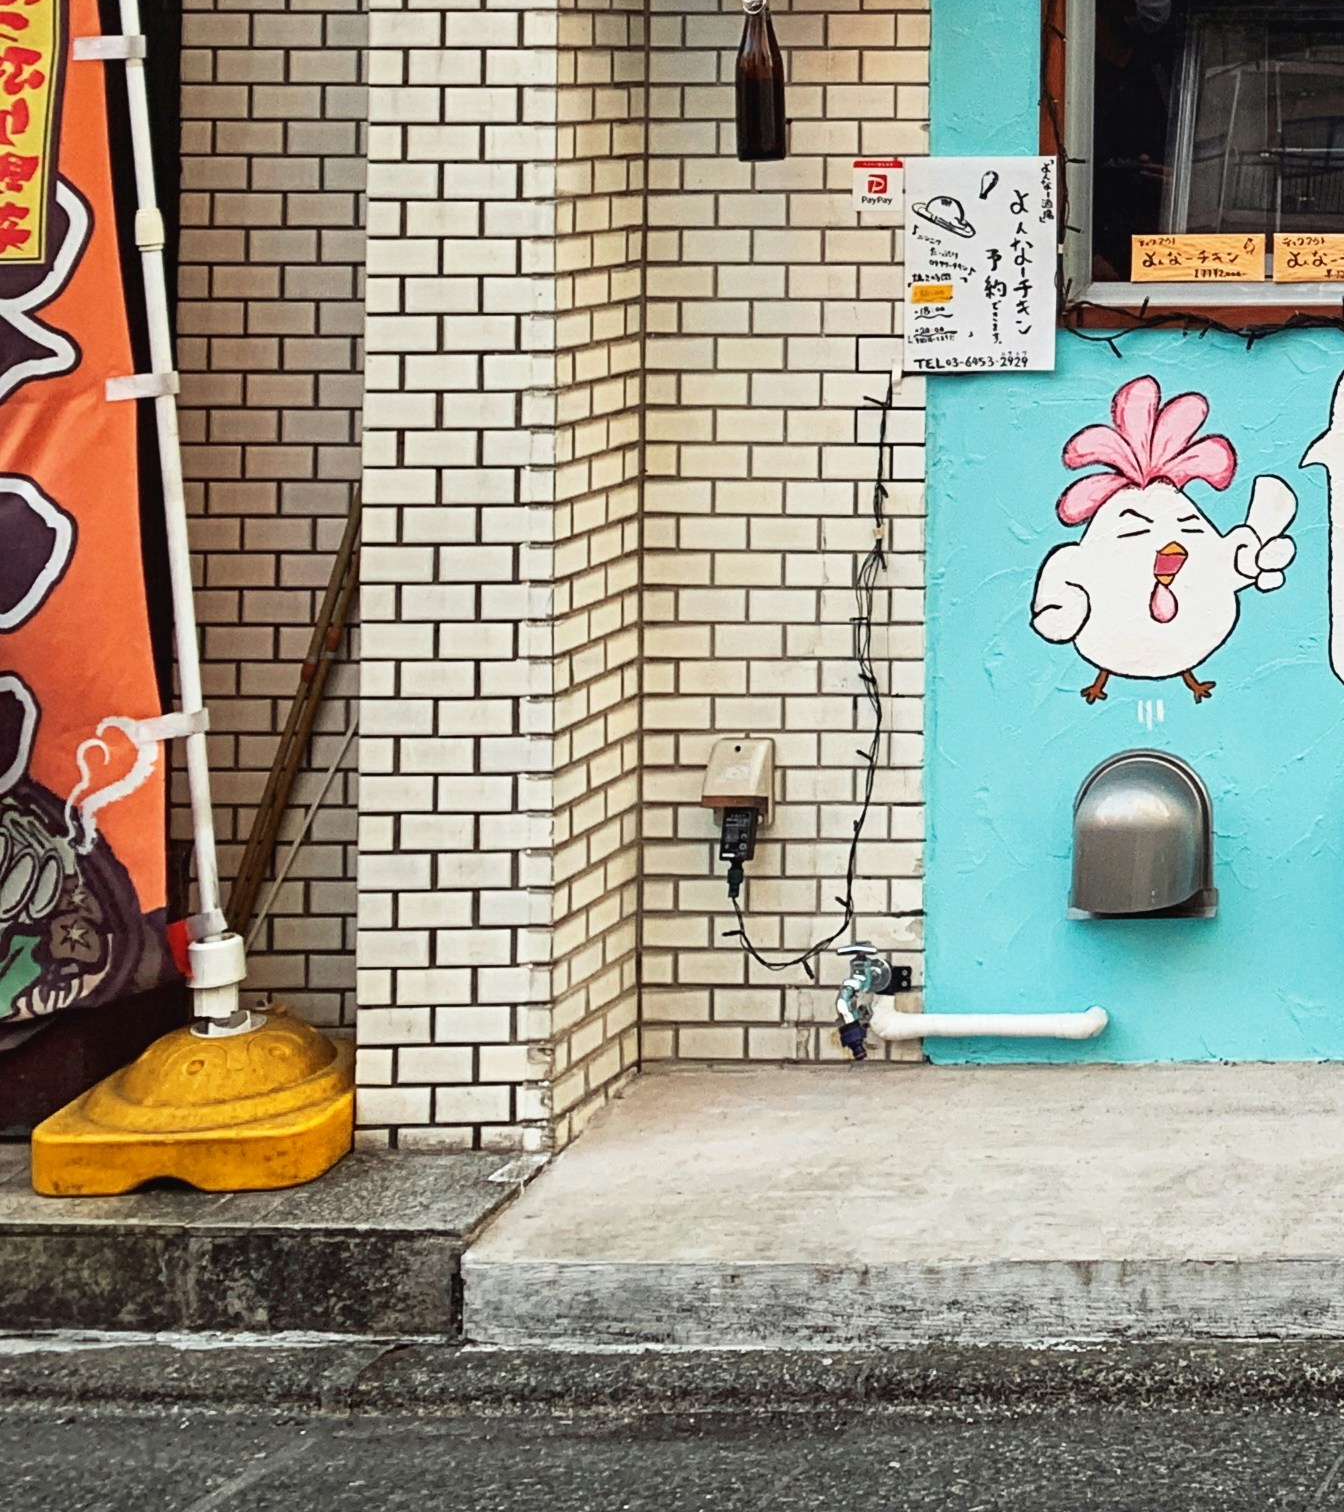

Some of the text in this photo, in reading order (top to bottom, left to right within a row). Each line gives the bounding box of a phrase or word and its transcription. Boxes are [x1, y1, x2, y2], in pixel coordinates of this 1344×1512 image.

[861, 196, 893, 206] PayPay
[1010, 189, 1034, 335] よんなーチキン
[913, 359, 946, 370] TEL
